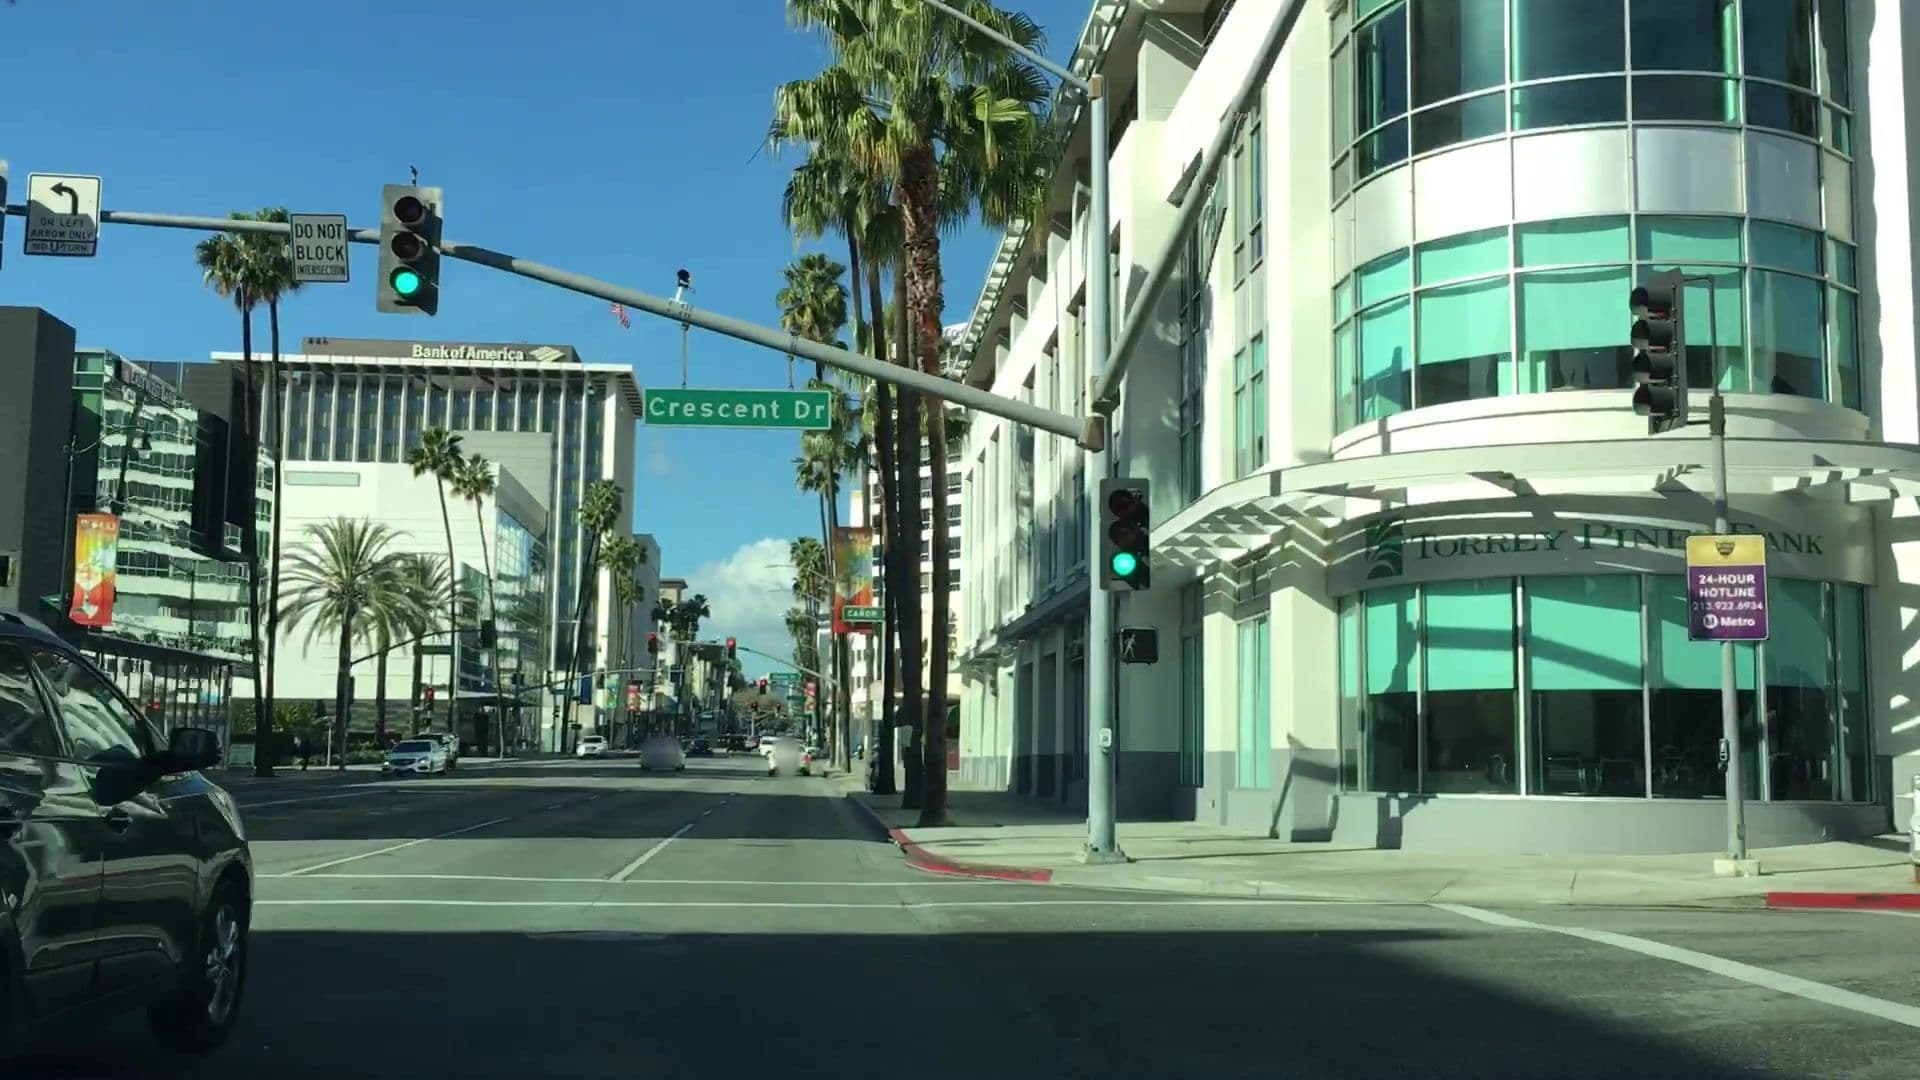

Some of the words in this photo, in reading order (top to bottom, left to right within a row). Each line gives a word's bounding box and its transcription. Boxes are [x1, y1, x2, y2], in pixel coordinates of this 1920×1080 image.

[60, 218, 83, 228] LEFT
[31, 228, 65, 238] ARROW
[69, 231, 94, 240] ONLY
[295, 223, 313, 239] DO
[317, 223, 343, 240] NOT
[296, 244, 345, 262] BLOCK
[412, 344, 450, 359] Bank
[451, 346, 465, 360] of
[466, 346, 525, 361] America
[648, 396, 780, 419] Crescent
[794, 400, 825, 420] Dr
[1412, 529, 1569, 560] TORREY
[1576, 522, 1692, 551] PINE
[1698, 573, 1756, 585] 24-HOUR
[1698, 587, 1756, 598] HOTLINE
[1720, 615, 1756, 627] Metro
